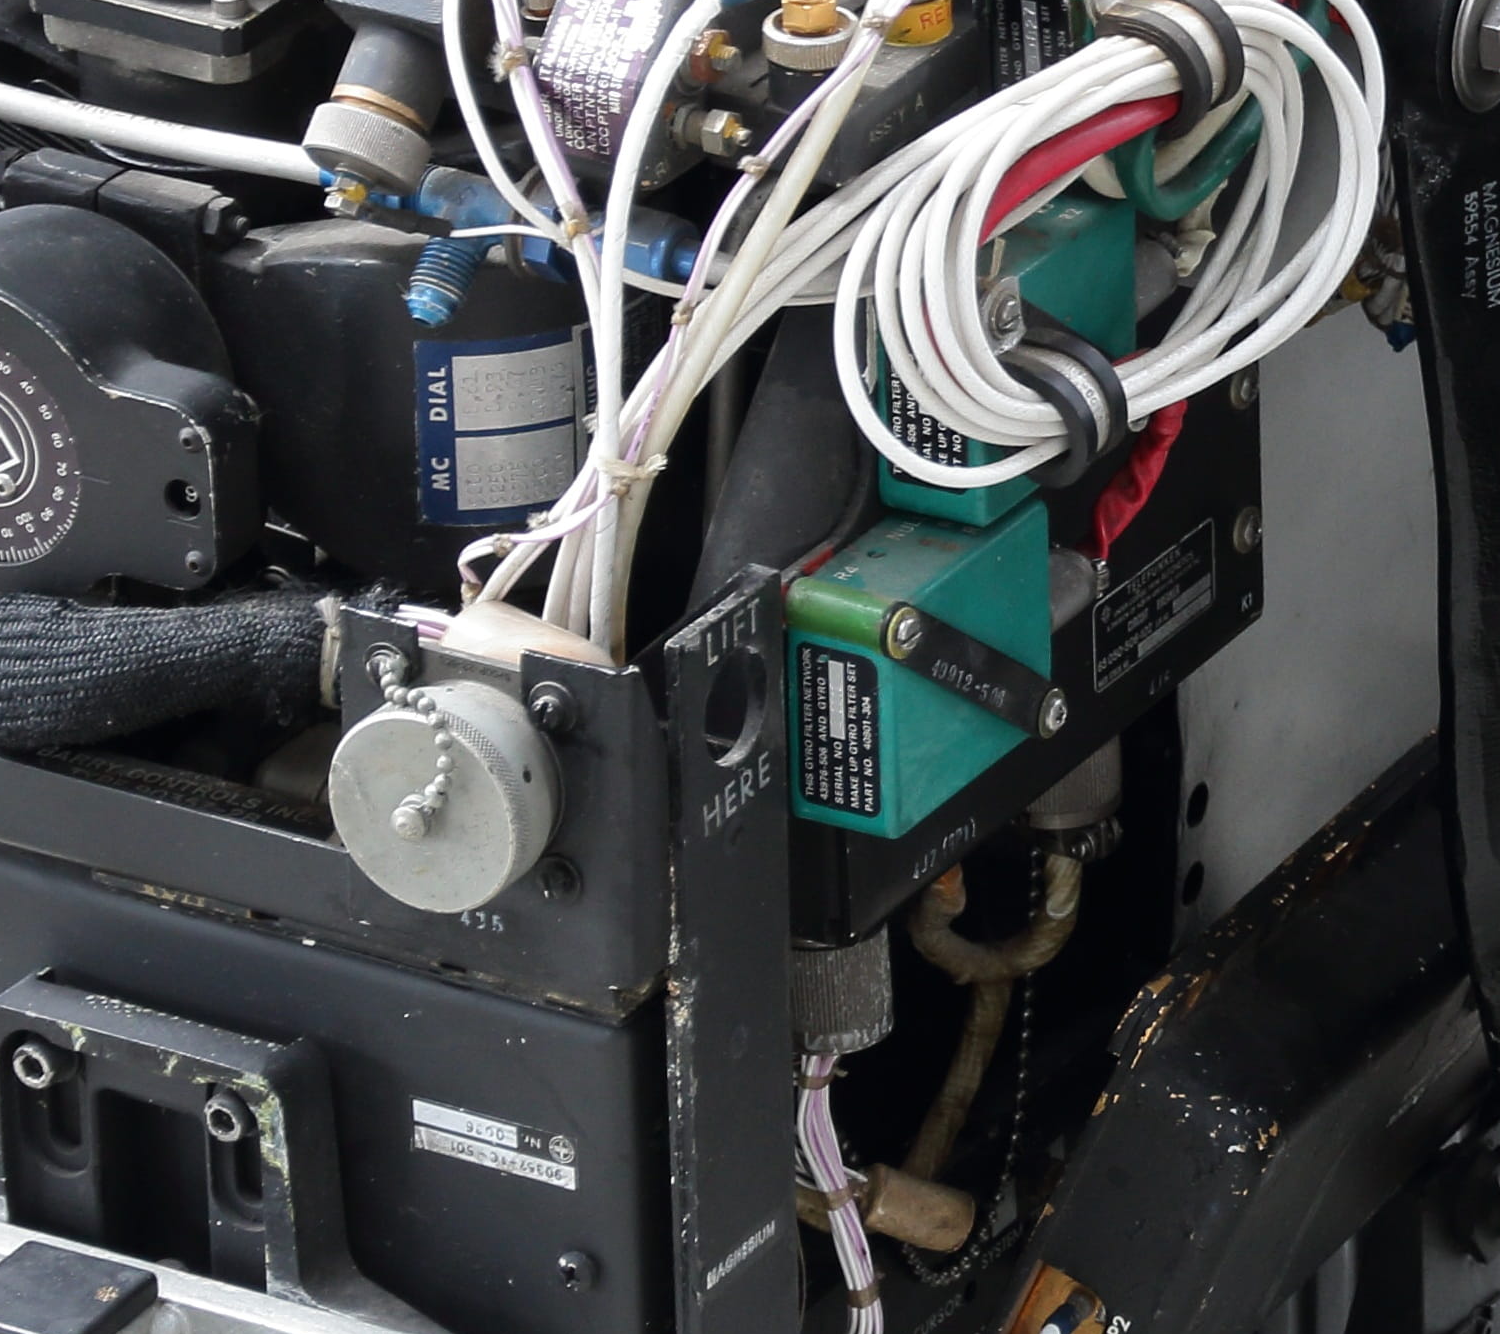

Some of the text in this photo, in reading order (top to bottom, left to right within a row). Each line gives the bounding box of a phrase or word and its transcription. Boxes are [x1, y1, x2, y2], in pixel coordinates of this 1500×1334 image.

[1465, 192, 1478, 244] 59554
[1484, 182, 1500, 306] MAGNESIUM
[20, 382, 34, 394] 40
[892, 378, 902, 414] FILTER
[39, 406, 53, 420] 50
[428, 368, 449, 490] MC DIAL
[922, 417, 931, 434] NO
[937, 432, 947, 447] UP
[57, 462, 67, 476] 70
[706, 598, 762, 667] LIFT
[815, 676, 827, 710] GYRO
[802, 646, 814, 795] THIS GYRO FILTER NETWORK
[817, 715, 827, 741] AND
[846, 661, 859, 809] MAKE UP GYRO FILTER SET
[130, 767, 263, 812] CONTROLS
[832, 740, 844, 804] SERIAL NO
[701, 753, 772, 838] HERE
[863, 780, 873, 811] PART
